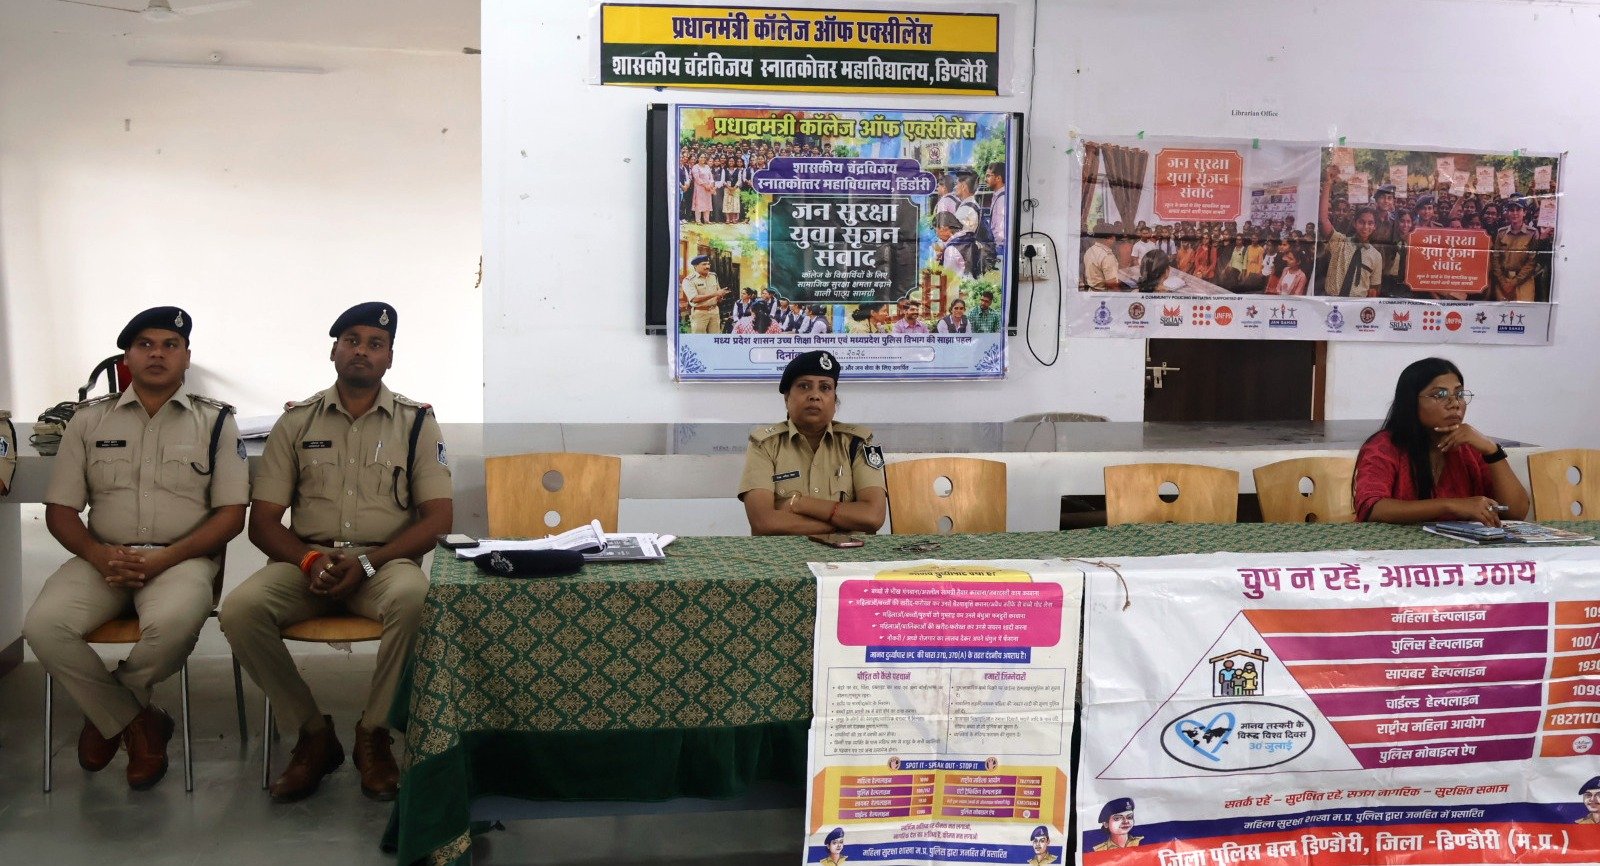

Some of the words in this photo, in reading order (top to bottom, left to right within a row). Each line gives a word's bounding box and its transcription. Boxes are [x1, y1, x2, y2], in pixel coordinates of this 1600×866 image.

[672, 12, 749, 40] प्रधानमंत्री
[754, 13, 810, 41] कॉलेज
[814, 15, 854, 43] ऑफ
[857, 17, 933, 45] एक्सीलेंस
[612, 52, 681, 77] शासकीय
[684, 52, 753, 77] चंद्रविजय
[760, 54, 838, 79] स्नातकोत्तर
[713, 114, 795, 138] प्रधानमंत्री
[799, 115, 856, 139] कॉलेज
[859, 117, 901, 139] ऑफ
[902, 118, 976, 142] एक्सीलेंस
[793, 159, 842, 175] शासकीय
[847, 160, 897, 176] चंद्रविजय
[1167, 158, 1189, 170] जन
[1193, 158, 1229, 172] सुरक्षा
[758, 176, 820, 192] स्नातकोत्तर
[1166, 173, 1192, 187] युवा
[1196, 173, 1229, 188] सृजन
[1180, 185, 1214, 199] संवाद
[791, 203, 831, 220] जन
[836, 203, 899, 226] सुरक्षा
[789, 226, 837, 249] युवा
[841, 226, 900, 249] सृजन
[1422, 234, 1441, 244] जन
[1445, 236, 1477, 247] सुरक्षा
[814, 244, 877, 267] संवाद
[1420, 247, 1443, 260] युवा
[1447, 248, 1475, 261] सृजन
[1432, 258, 1462, 271] संवाद
[801, 269, 823, 278] कॉलेज
[825, 270, 832, 278] के
[866, 270, 873, 278] के
[874, 270, 888, 279] लिए
[797, 279, 830, 288] सामाजिक
[831, 281, 850, 289] सुरक्षा
[814, 289, 832, 297] वाली
[852, 289, 875, 297] सामग्री
[733, 337, 751, 345] प्रदेश
[794, 335, 812, 345] शिक्षा
[813, 335, 836, 344] विभाग
[838, 336, 848, 344] एवं
[850, 335, 880, 344] मध्यप्रदेश
[882, 335, 902, 346] पुलिस
[904, 335, 925, 344] विभाग
[926, 335, 936, 343] की
[1237, 568, 1281, 599] चुप
[1286, 568, 1315, 591] न
[1378, 563, 1464, 588] आवाज
[1391, 610, 1429, 623] महिला
[1432, 609, 1487, 622] हेल्पलाइन
[1391, 637, 1426, 654] पुलिस
[1428, 637, 1485, 650] हेल्पलाइन
[949, 651, 967, 659] 370(A)
[1385, 668, 1426, 679] सायबर
[1431, 665, 1487, 678] हेल्पलाइन
[1385, 695, 1421, 709] चाईल्ड
[1425, 694, 1480, 708] हेल्पलाइन
[1266, 720, 1294, 729] तस्करी
[1296, 720, 1305, 728] के
[1377, 720, 1409, 735] राष्ट्रीय
[1411, 718, 1448, 732] महिला
[1451, 716, 1486, 729] आयोग
[1262, 730, 1283, 739] विश्व
[1285, 730, 1307, 739] दिवस
[1249, 742, 1262, 750] 30
[1264, 740, 1293, 753] जुलाई
[1379, 748, 1414, 763] पुलिस
[1415, 746, 1460, 758] मोबाइल
[1461, 743, 1477, 756] ऐप
[959, 762, 971, 770] STOP
[1224, 796, 1253, 809] सतर्क
[1256, 794, 1273, 806] रहें
[1285, 790, 1326, 806] सुरक्षित
[1377, 786, 1421, 798] नागरिक
[1435, 785, 1475, 798] सुरक्षित
[1476, 784, 1510, 794] समाज
[1243, 819, 1276, 829] महिला
[1277, 817, 1303, 829] सुरक्षा
[1304, 814, 1331, 823] शाखा
[1332, 813, 1354, 823] म.प्र.
[1355, 810, 1383, 823] पुलिस
[1385, 811, 1403, 822] द्वारा
[1405, 809, 1438, 819] जनहित
[1441, 809, 1450, 819] में
[1451, 808, 1485, 819] प्रसारित
[863, 847, 880, 857] महिला
[882, 848, 897, 858] सुरक्षा
[929, 846, 946, 858] पुलिस
[947, 848, 958, 857] द्वारा
[959, 848, 979, 857] जनहित
[987, 848, 1007, 858] प्रसारित
[1158, 849, 1206, 866] जिला
[1265, 840, 1297, 858] बल
[1301, 832, 1369, 855] डिण्डौरी,
[1376, 831, 1424, 852] जिला
[1507, 828, 1569, 855] (म.प्र.)
